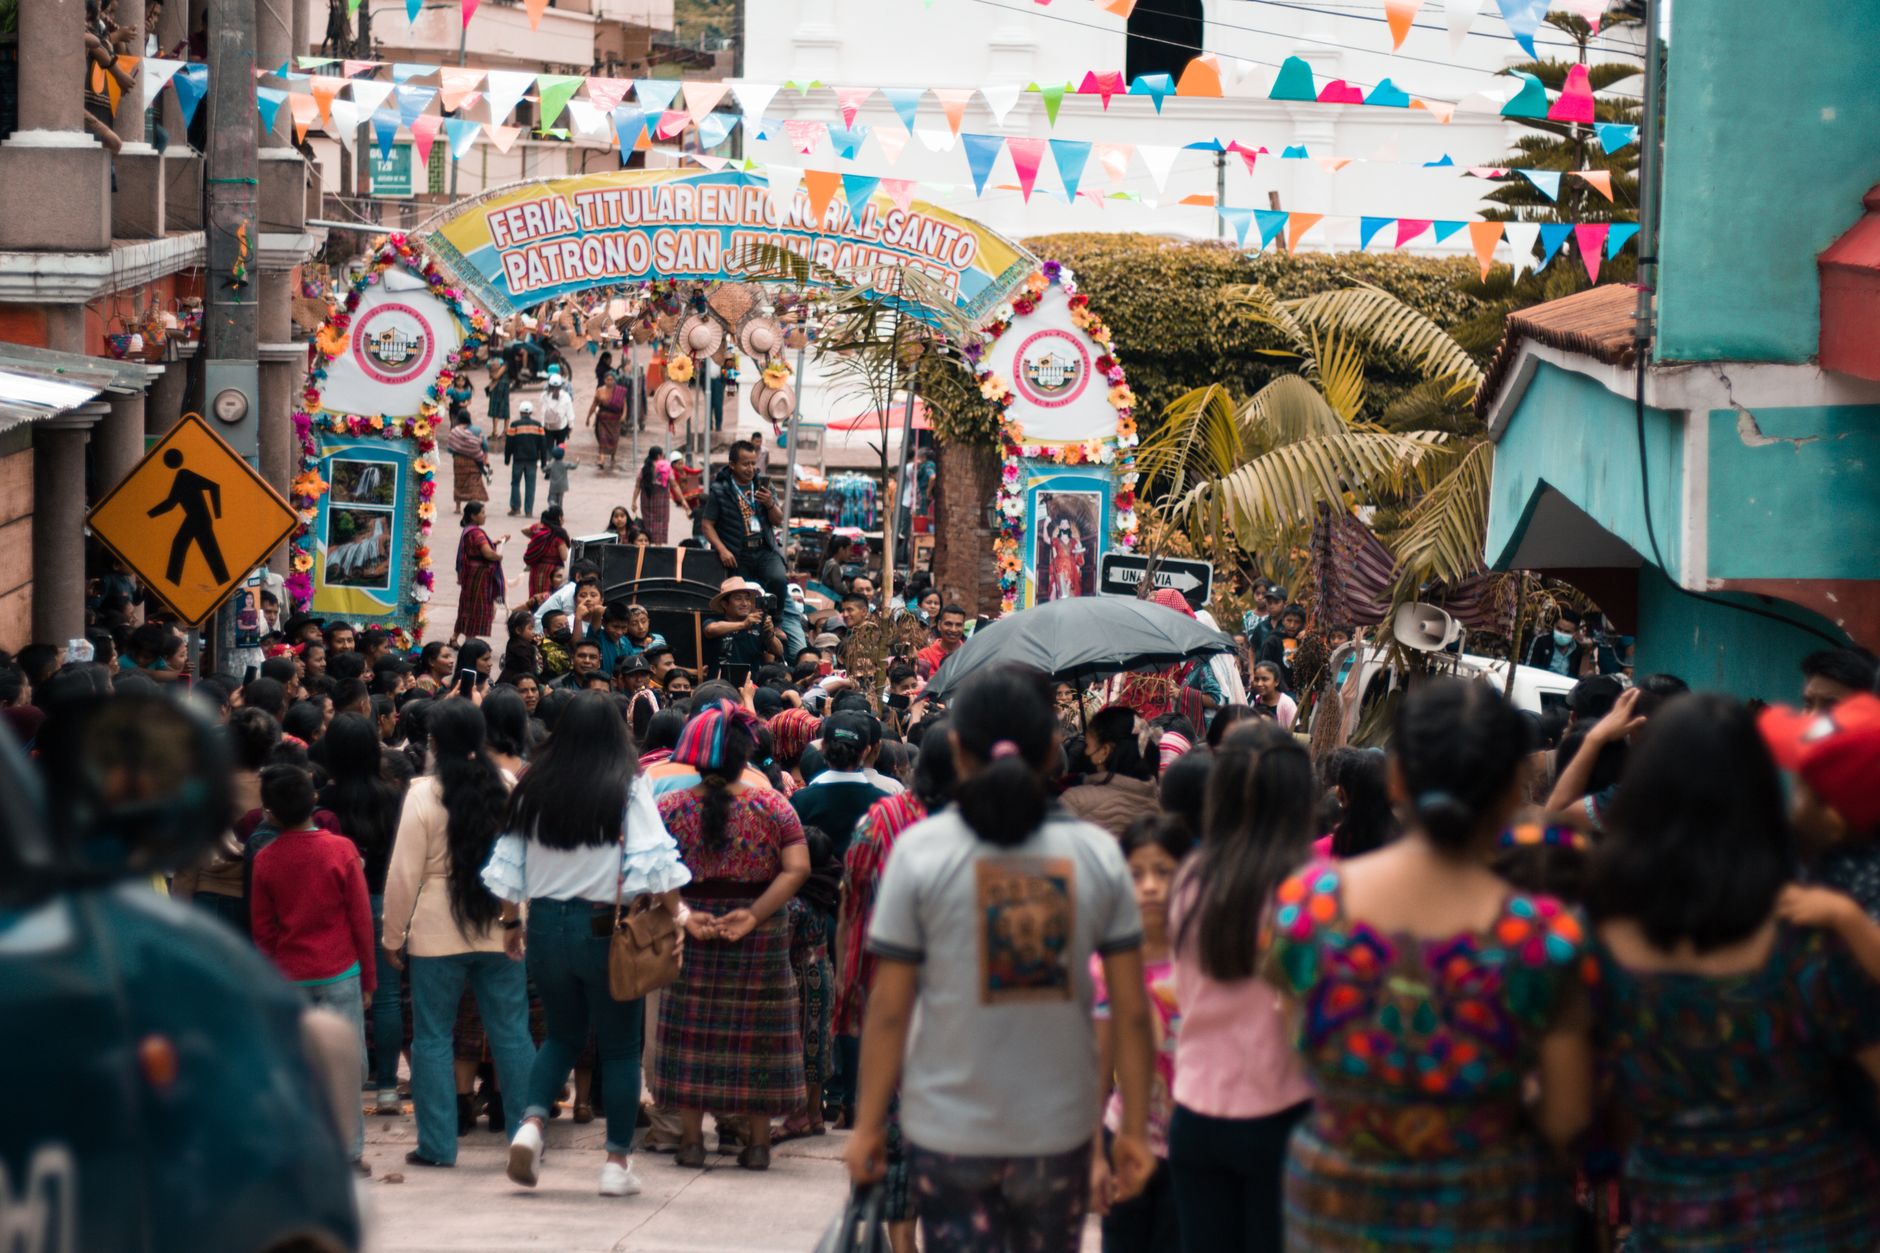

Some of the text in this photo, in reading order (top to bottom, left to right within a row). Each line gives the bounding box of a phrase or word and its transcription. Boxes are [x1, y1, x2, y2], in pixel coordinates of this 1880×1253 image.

[487, 194, 577, 249] FERIA
[576, 186, 696, 229] TITULAR
[699, 186, 738, 223] EN
[884, 208, 978, 270] SANTO
[503, 231, 651, 293] PATRONO
[654, 229, 719, 273] SAN
[1154, 572, 1172, 586] VIA
